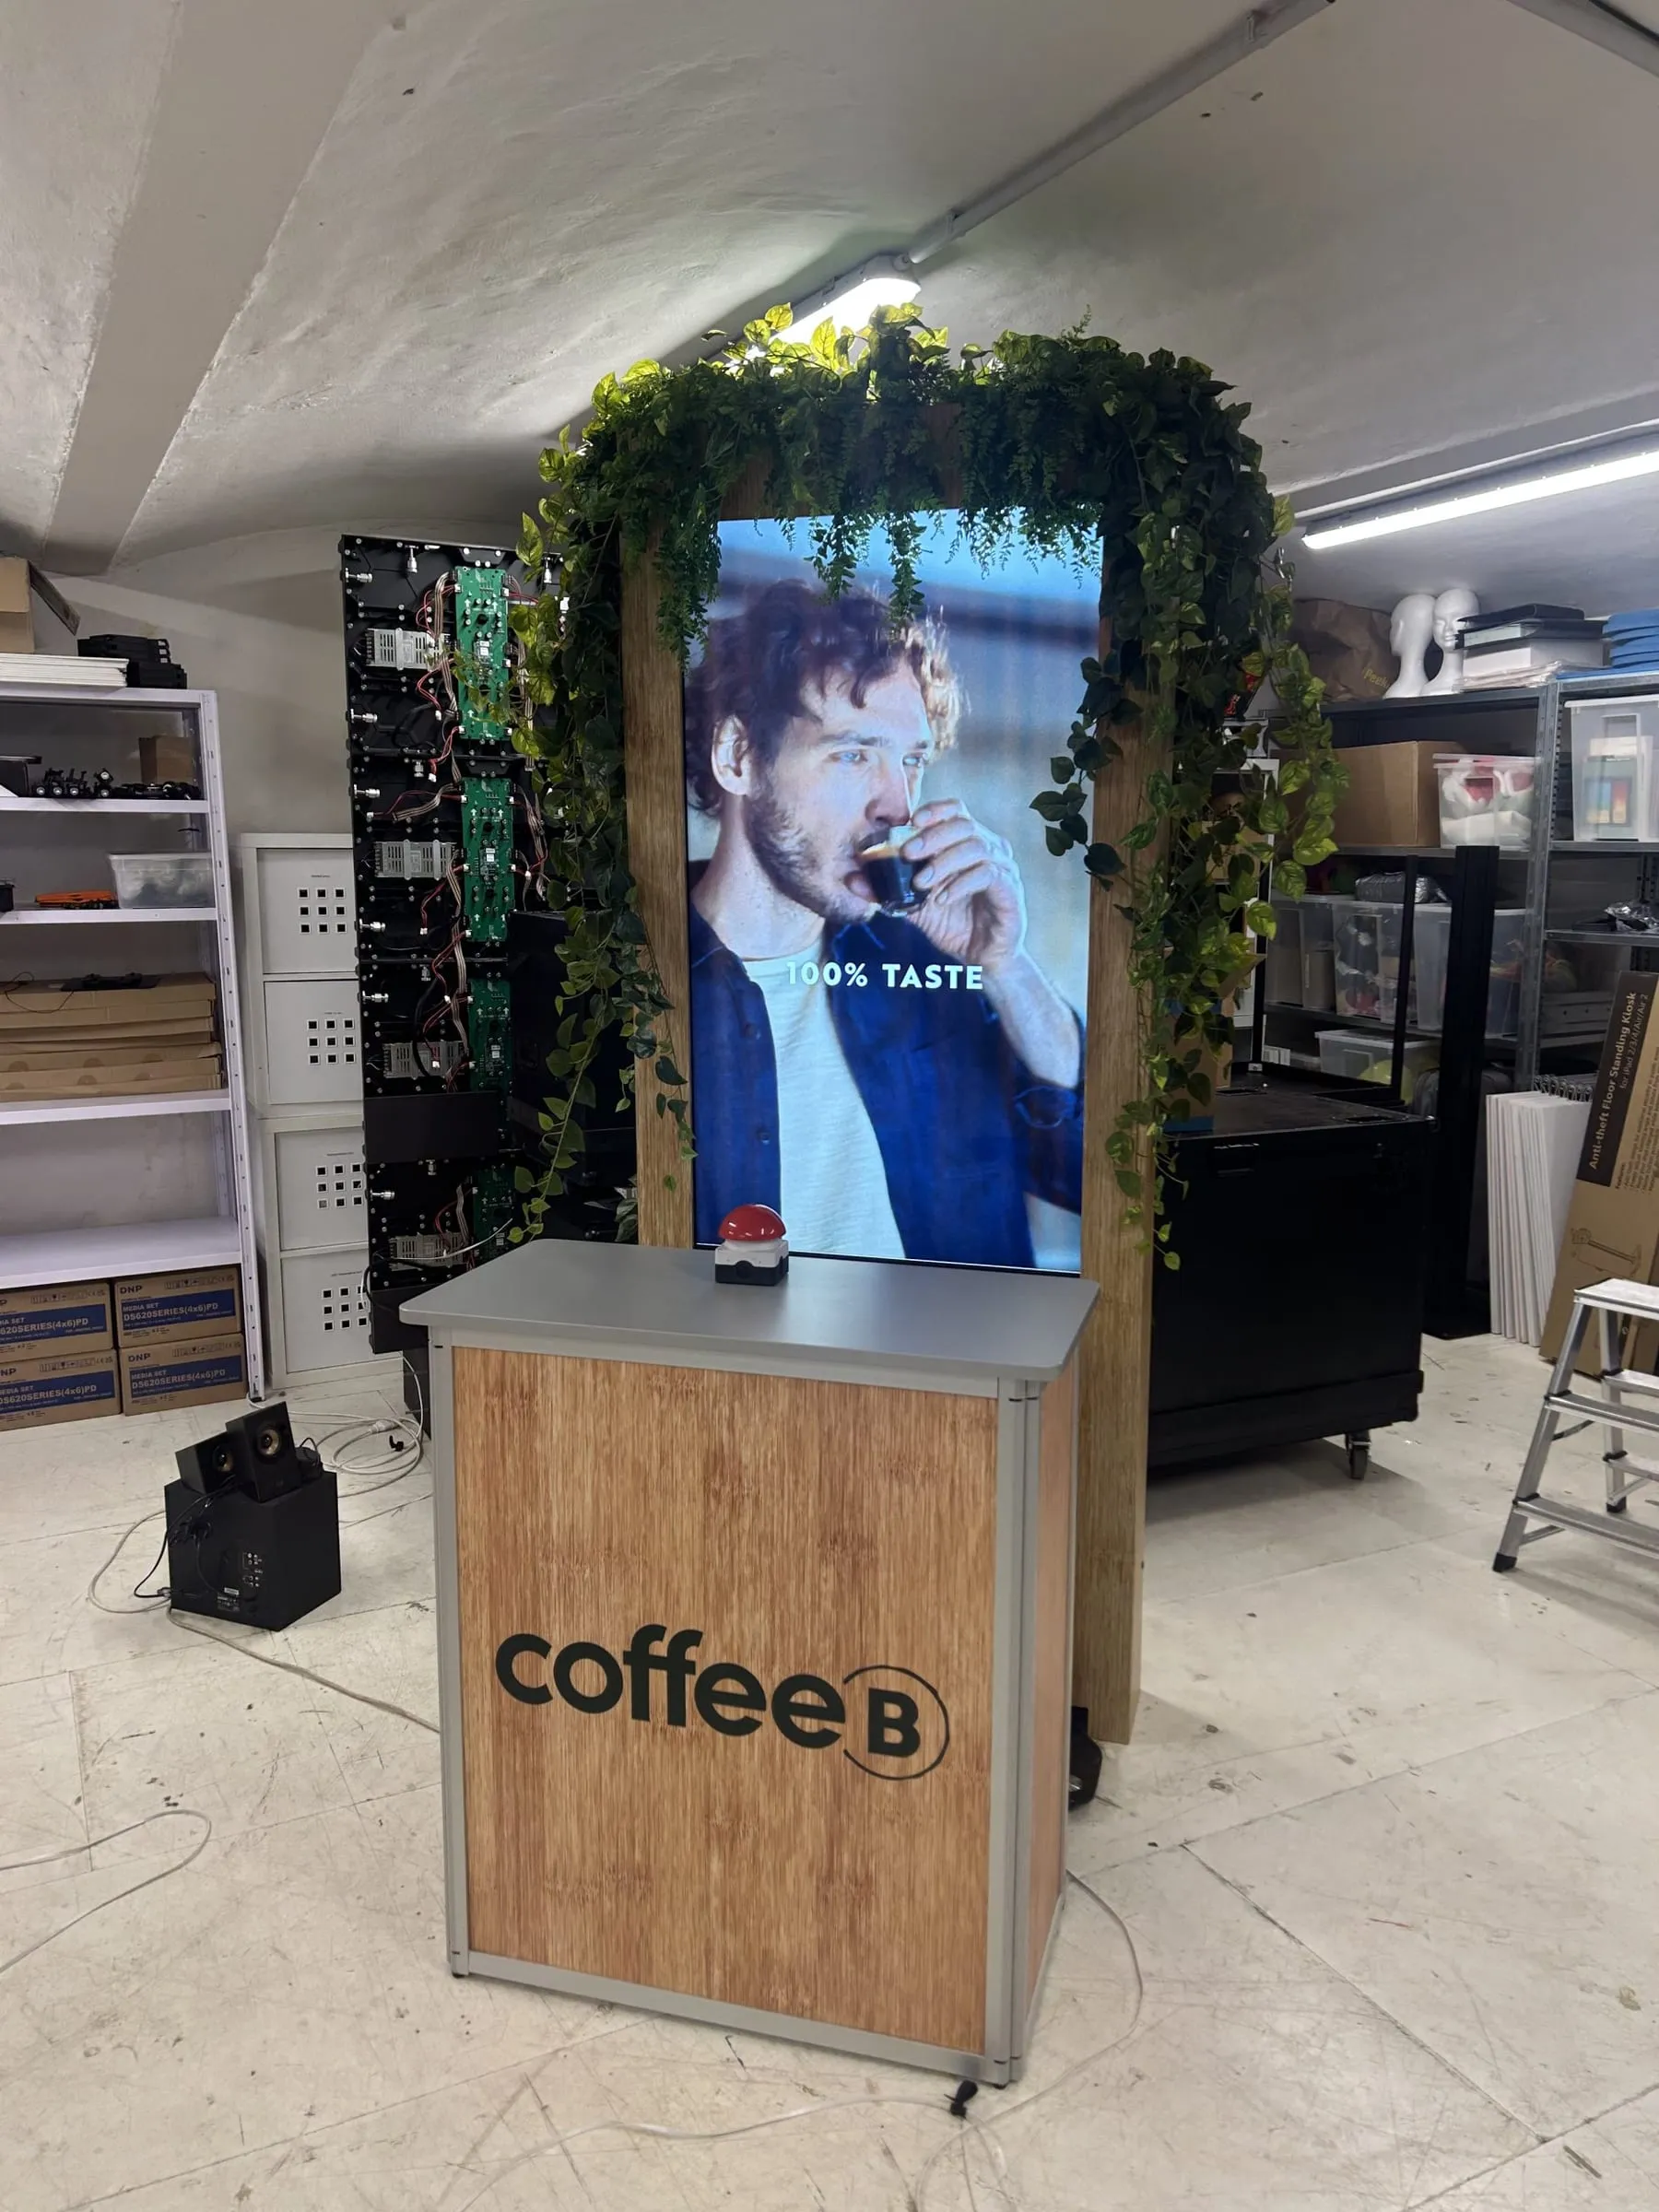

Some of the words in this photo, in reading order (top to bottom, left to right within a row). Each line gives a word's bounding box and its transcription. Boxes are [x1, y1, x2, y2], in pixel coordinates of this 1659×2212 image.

[786, 961, 868, 987] 100%
[882, 963, 983, 989] TASTE
[1622, 992, 1637, 1024] Kiosk
[1609, 1027, 1630, 1077] Standing
[1602, 1080, 1617, 1110] Floor
[1589, 1112, 1609, 1170] Anti-theft
[120, 1285, 143, 1294] DNP
[123, 1304, 145, 1312] MEDIA
[124, 1302, 218, 1322] DS620SERIES(4x6)PD
[0, 1318, 88, 1335] 620SERIES(4x6)PD
[128, 1352, 151, 1362] DNP
[0, 1368, 17, 1376] NP
[131, 1371, 153, 1380] MEDIA
